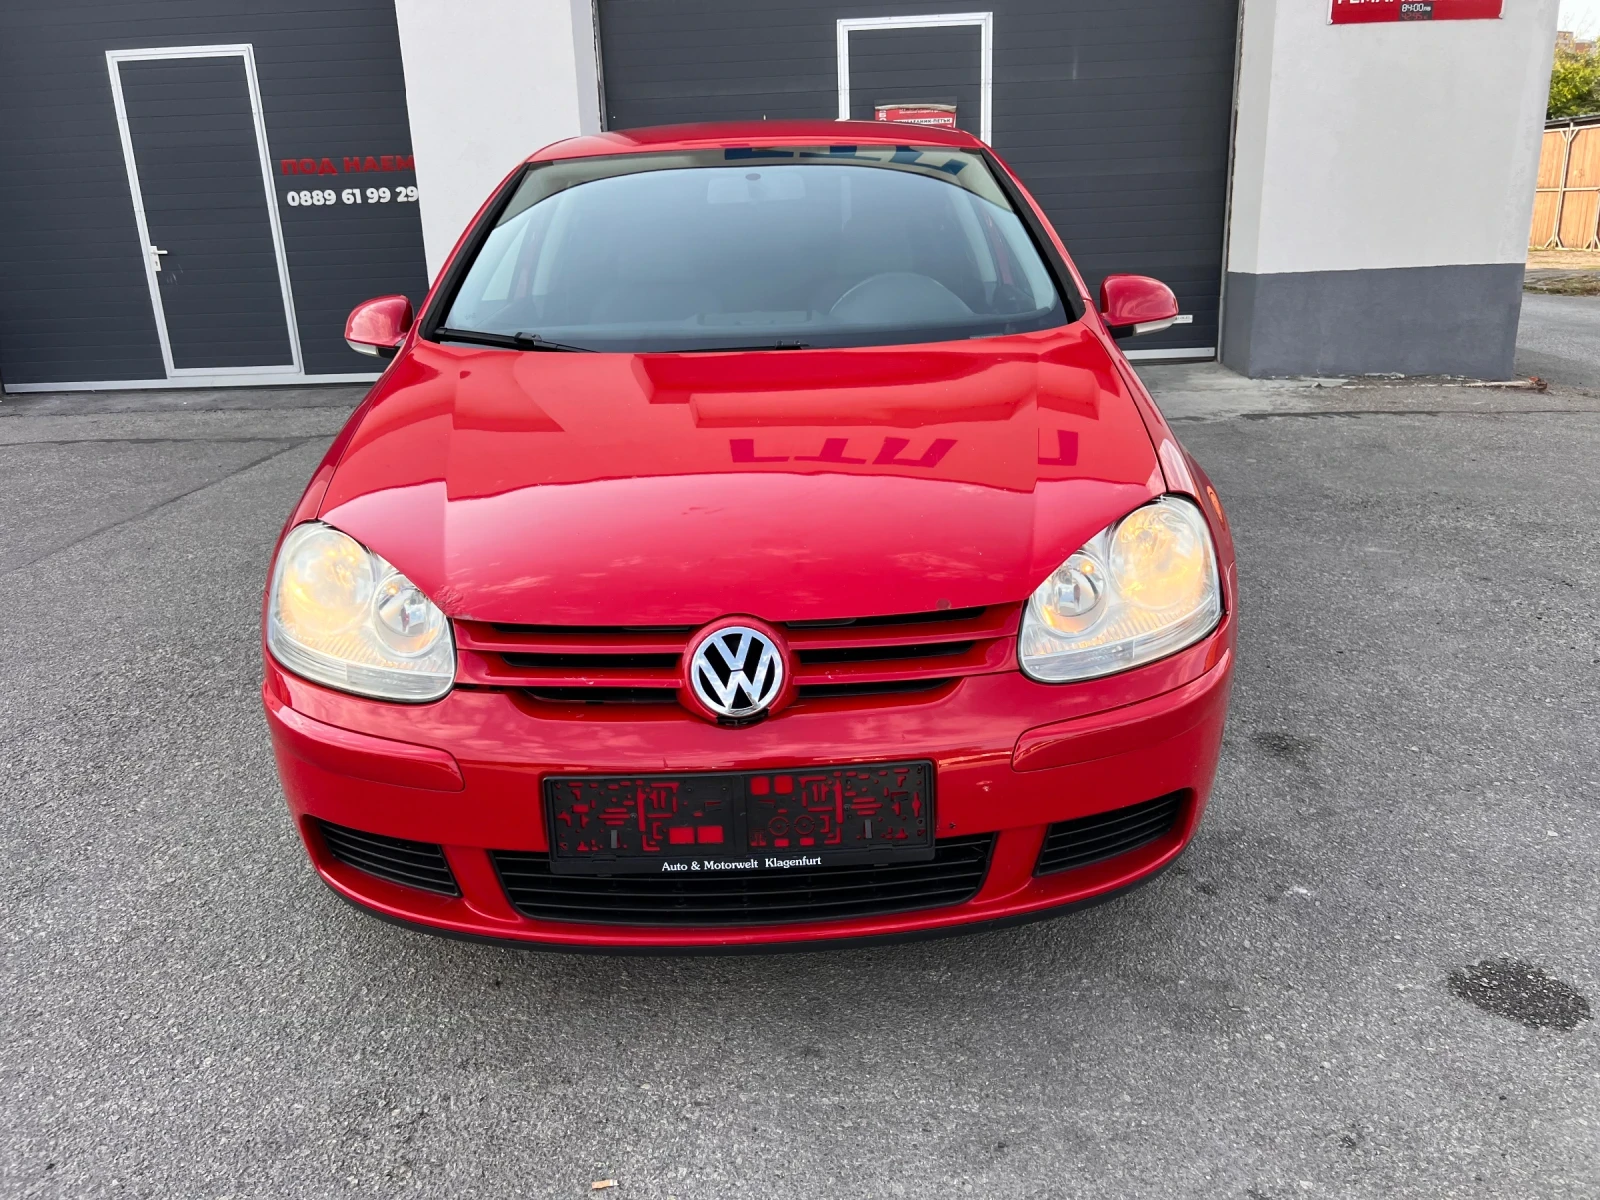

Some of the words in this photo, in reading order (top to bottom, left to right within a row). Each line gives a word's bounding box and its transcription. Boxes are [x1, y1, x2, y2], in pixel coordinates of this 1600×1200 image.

[281, 157, 338, 176] ПОД
[343, 154, 415, 173] НАЕМ
[286, 189, 337, 207] 0889
[341, 188, 362, 205] 61
[366, 187, 391, 204] 99
[395, 185, 419, 203] 29
[692, 627, 782, 716] VW
[662, 861, 688, 872] Auto
[690, 860, 701, 871] &
[704, 859, 758, 870] Motorwelt
[765, 856, 822, 869] Klagenfurt
